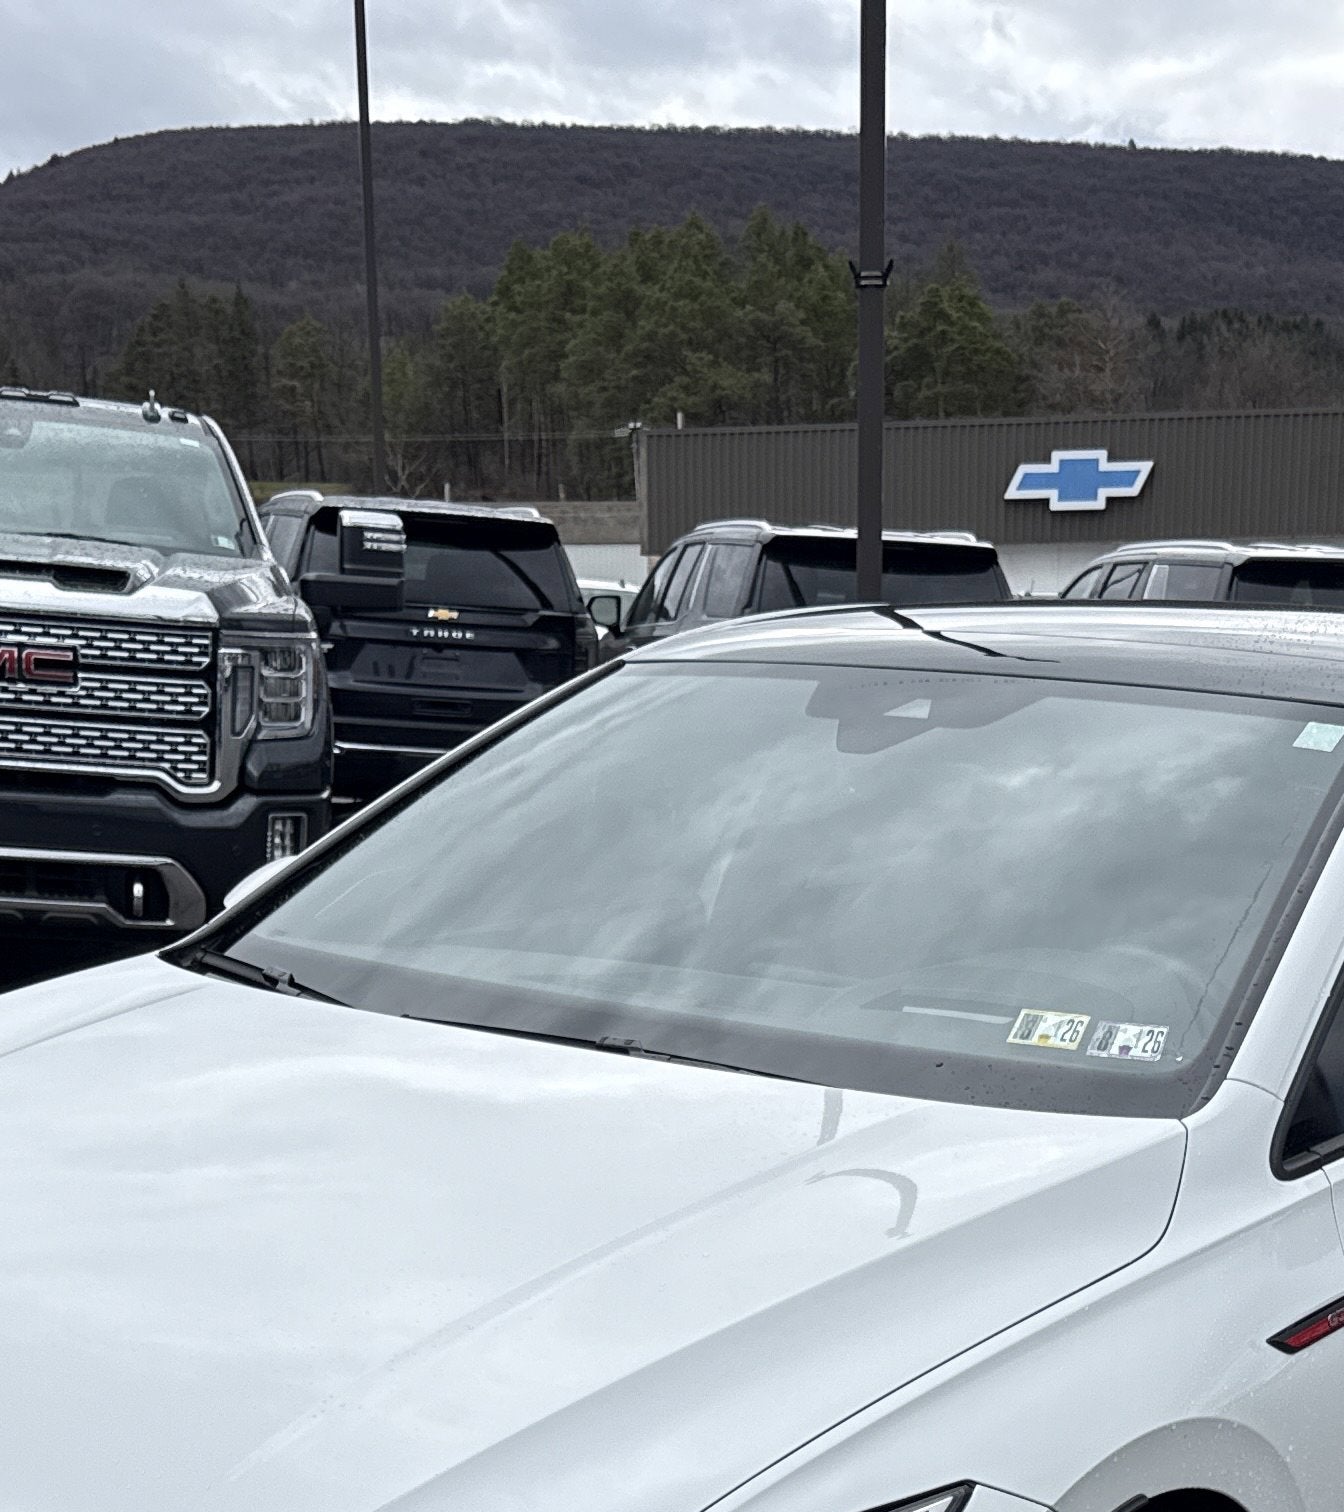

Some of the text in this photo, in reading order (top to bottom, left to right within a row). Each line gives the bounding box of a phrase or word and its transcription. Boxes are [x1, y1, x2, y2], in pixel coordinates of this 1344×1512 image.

[410, 627, 475, 640] TAHOE
[1060, 1019, 1084, 1043] 26
[1141, 1029, 1164, 1054] 26
